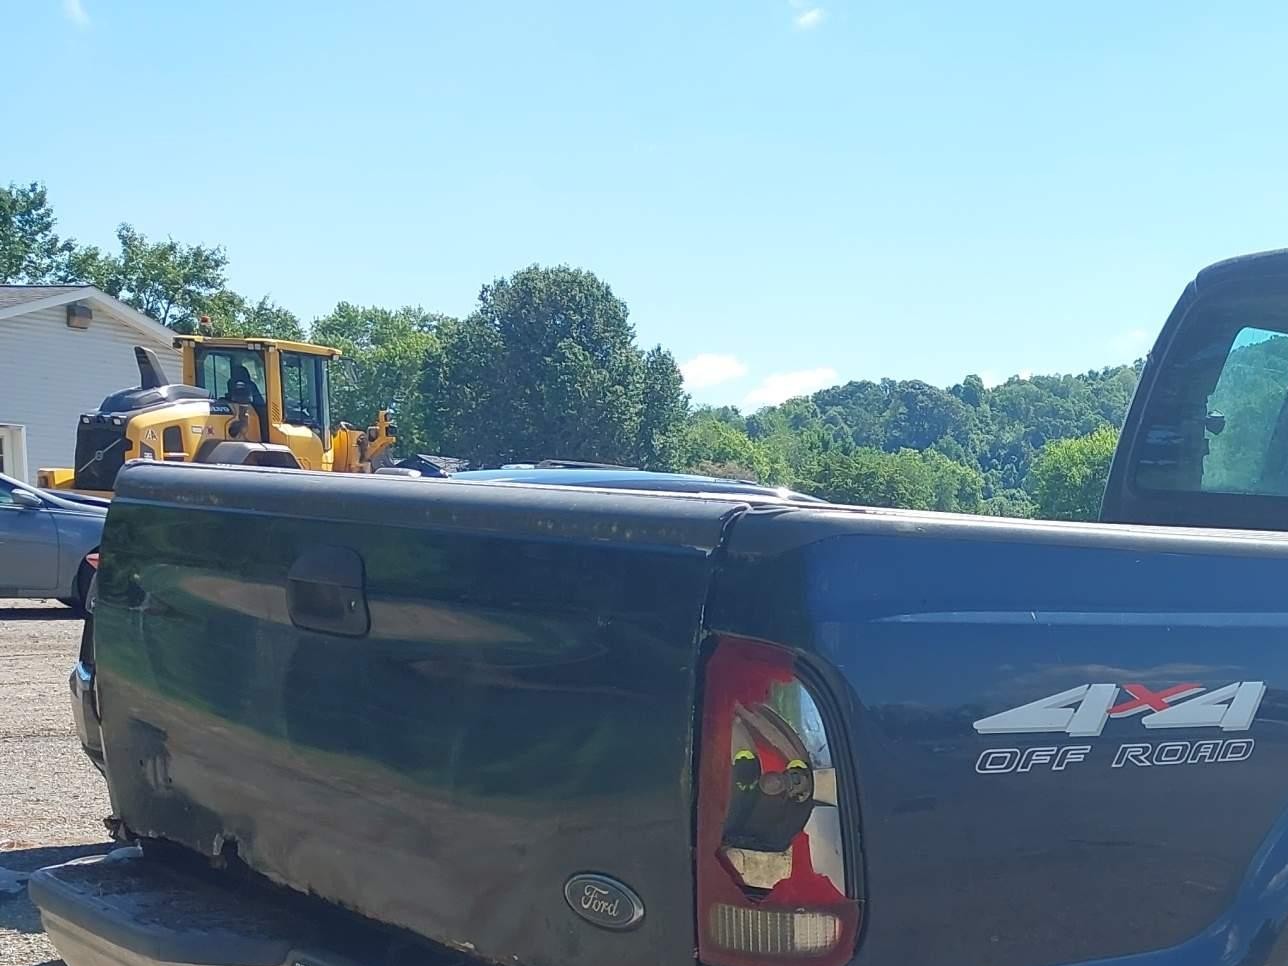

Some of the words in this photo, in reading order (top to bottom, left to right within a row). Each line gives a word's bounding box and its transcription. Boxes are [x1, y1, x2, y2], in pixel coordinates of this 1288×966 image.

[975, 745, 1091, 774] OFF
[1111, 738, 1255, 768] ROAD
[581, 884, 620, 917] Ford
